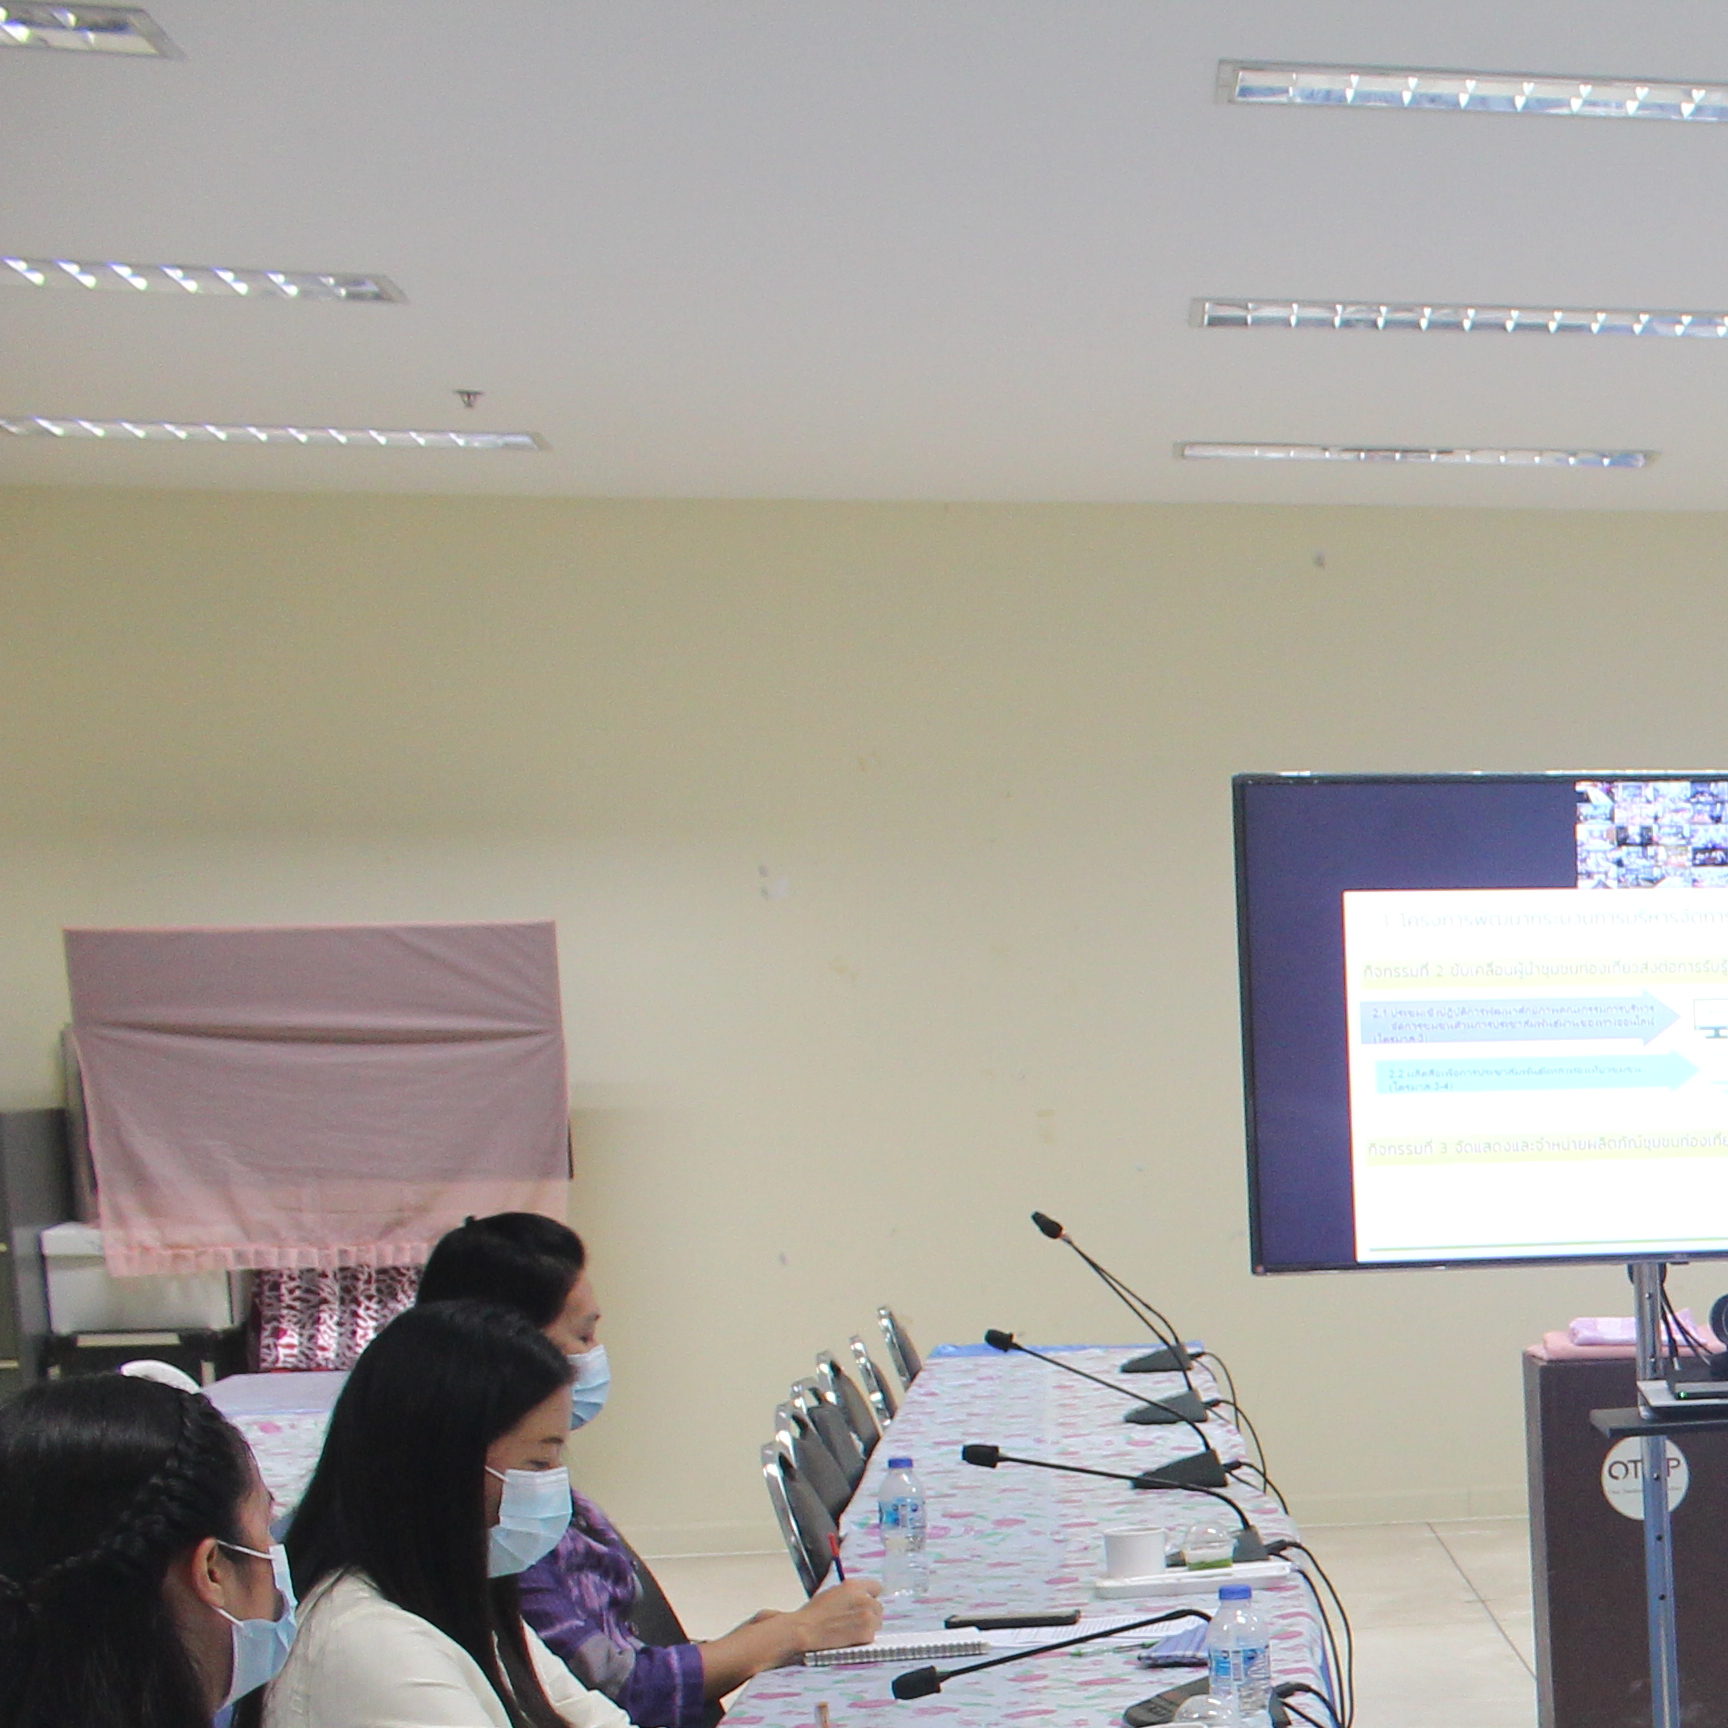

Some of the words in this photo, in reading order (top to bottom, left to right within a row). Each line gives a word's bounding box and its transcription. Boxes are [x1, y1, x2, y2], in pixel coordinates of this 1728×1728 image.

[1364, 960, 1430, 979] กิจกรรมที่
[1436, 965, 1444, 978] 2
[1388, 1068, 1405, 1079] 2.2
[1368, 1139, 1433, 1157] กิจกรรมที่
[1440, 1142, 1448, 1155] 3
[1608, 1457, 1681, 1481] OTP
